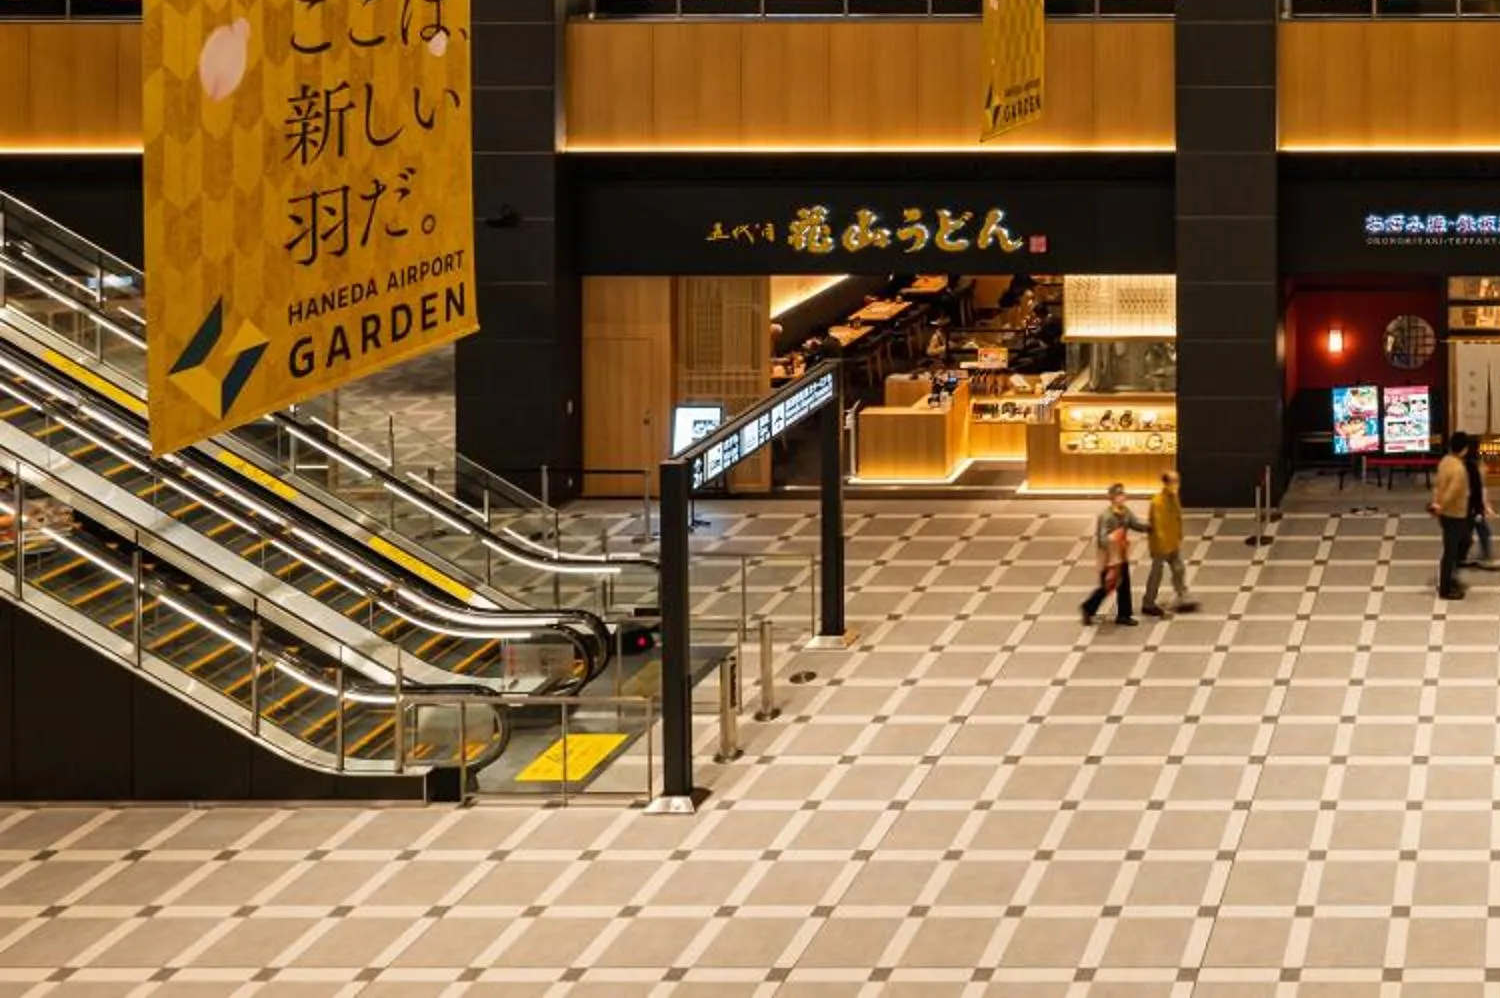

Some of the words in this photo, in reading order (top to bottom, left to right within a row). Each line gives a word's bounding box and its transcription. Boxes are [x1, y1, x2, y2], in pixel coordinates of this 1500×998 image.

[283, 79, 460, 166] 新しい
[284, 166, 437, 267] 羽だ。
[287, 277, 379, 327] HANEDA
[386, 249, 465, 292] AIRPORT
[287, 281, 467, 379] GARDEN
